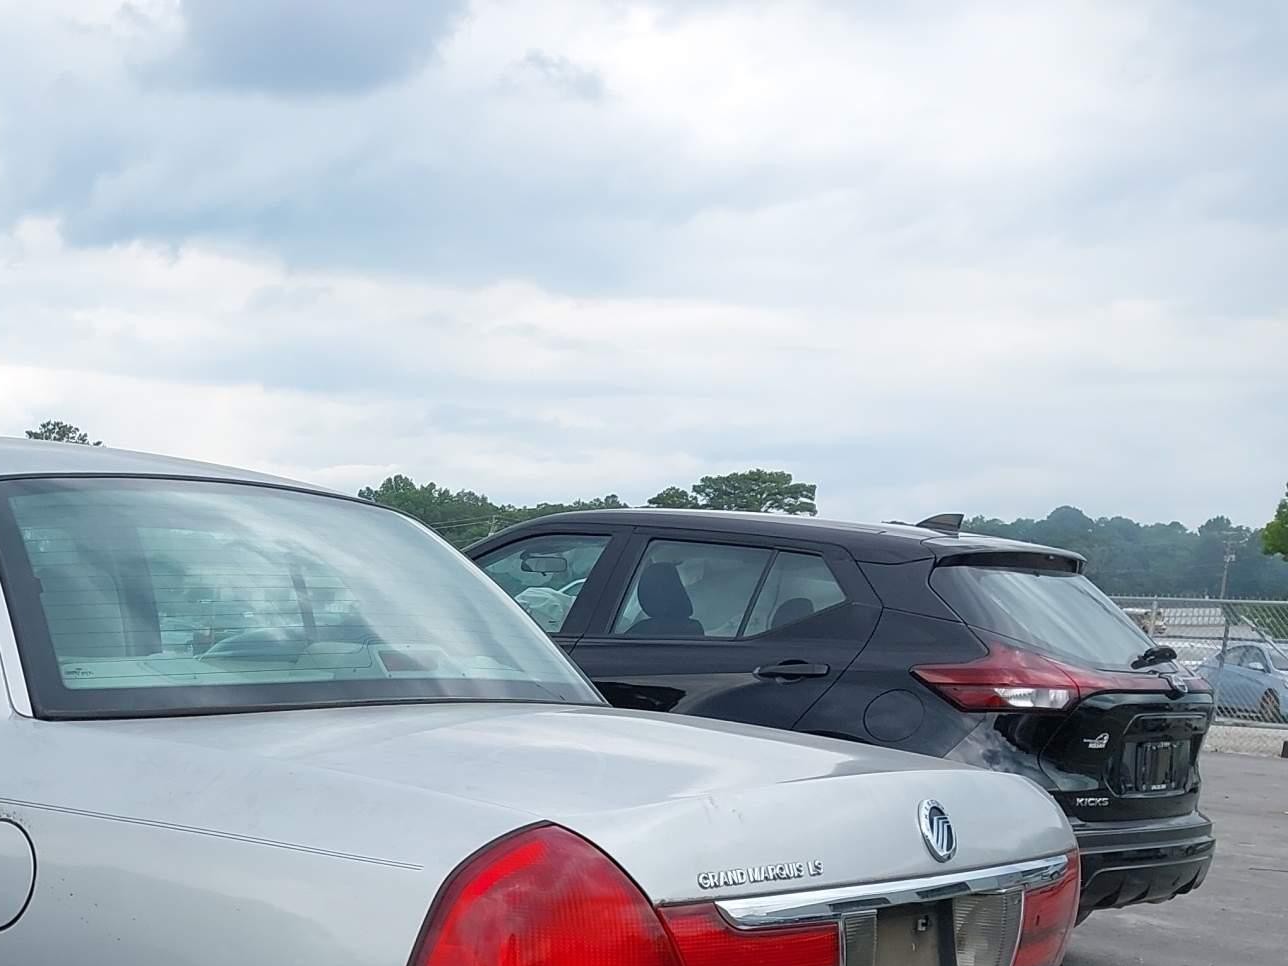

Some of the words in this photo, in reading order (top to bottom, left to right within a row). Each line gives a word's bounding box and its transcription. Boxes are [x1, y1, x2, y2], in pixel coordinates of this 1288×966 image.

[1076, 797, 1109, 806] KICKS
[698, 868, 746, 889] GRAND
[747, 862, 804, 882] MARQUIS
[807, 860, 824, 876] LS
